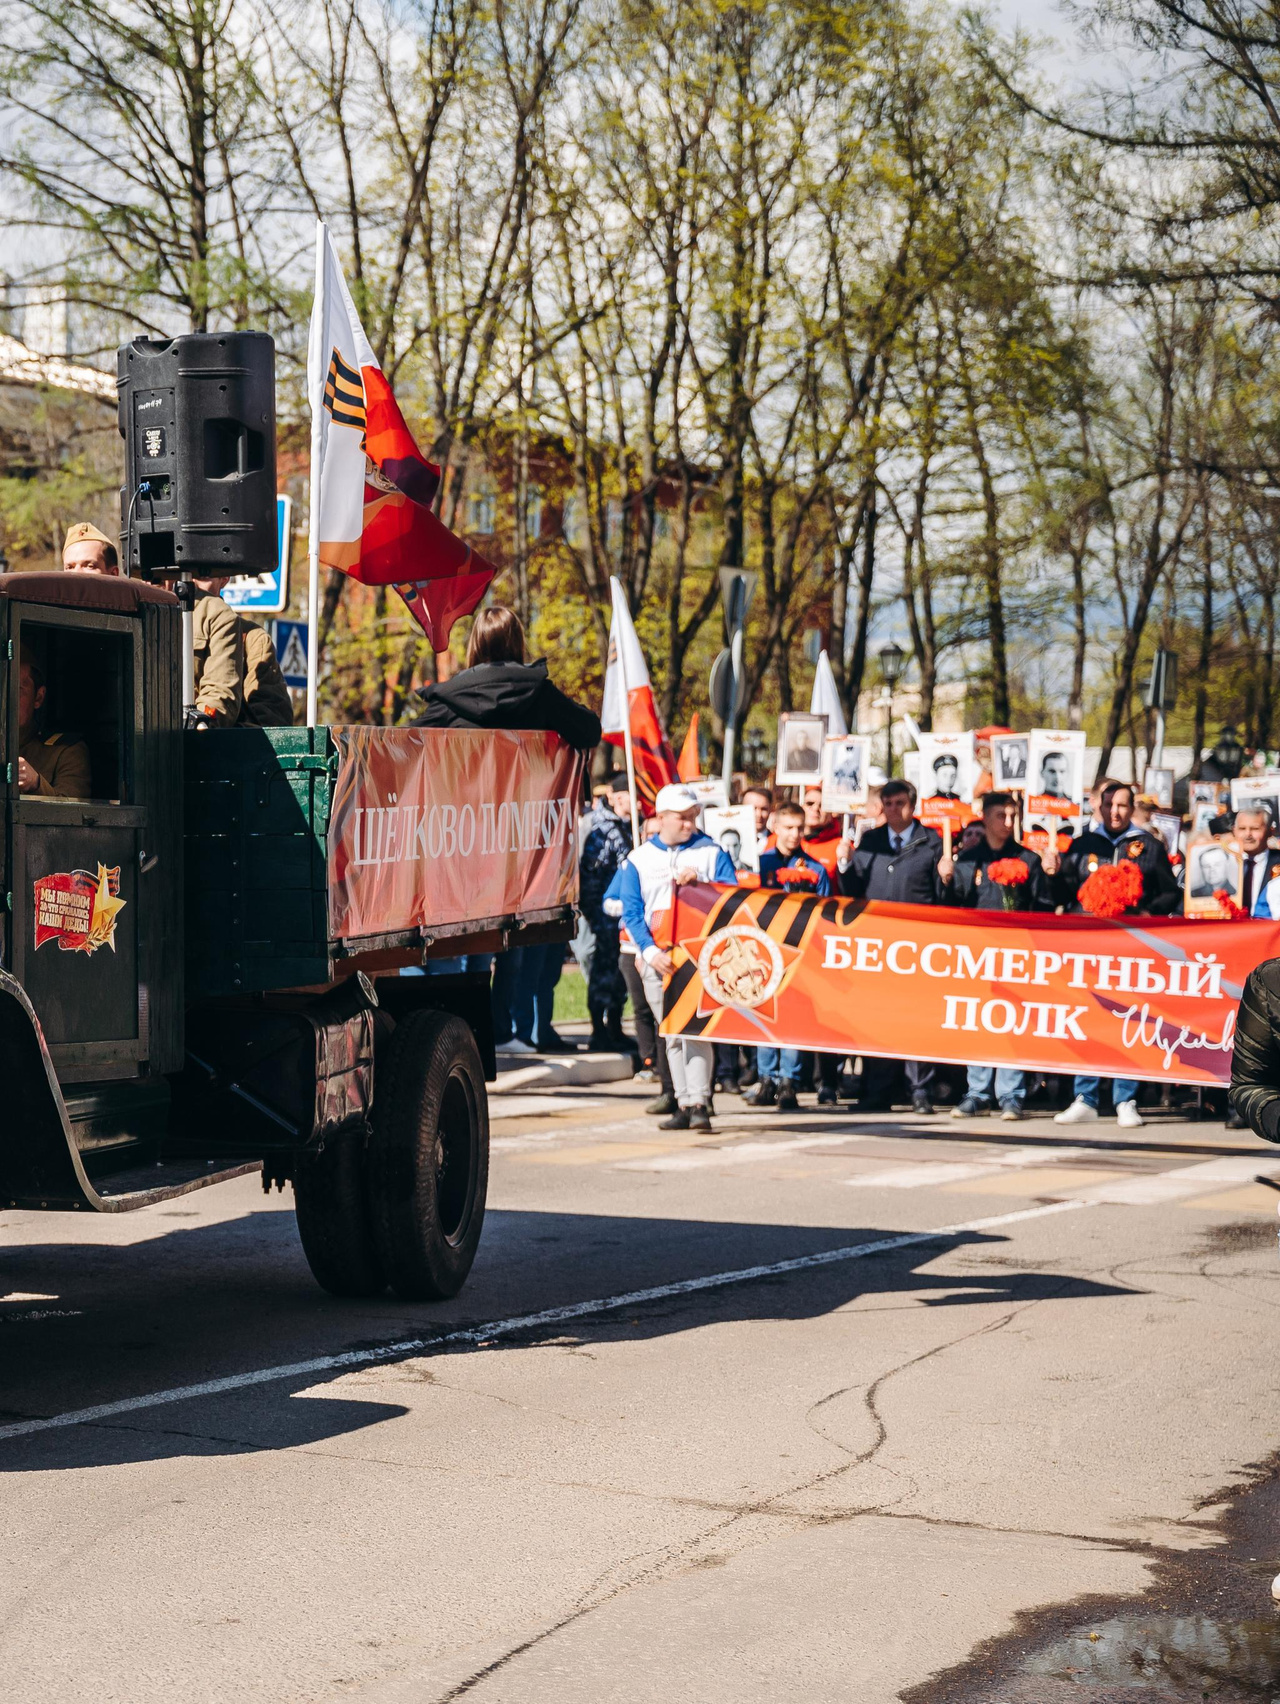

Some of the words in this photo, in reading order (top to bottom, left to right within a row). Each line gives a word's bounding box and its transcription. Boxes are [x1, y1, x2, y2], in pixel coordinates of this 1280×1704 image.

[353, 792, 476, 881] ЩЁЛКОВО
[480, 797, 574, 856] ПОМНИТ!
[41, 888, 56, 902] МЫ
[39, 912, 63, 927] НАШИ
[821, 934, 1225, 1000] БЕССМЕРТНЫЙ
[941, 995, 1090, 1042] ПОЛК
